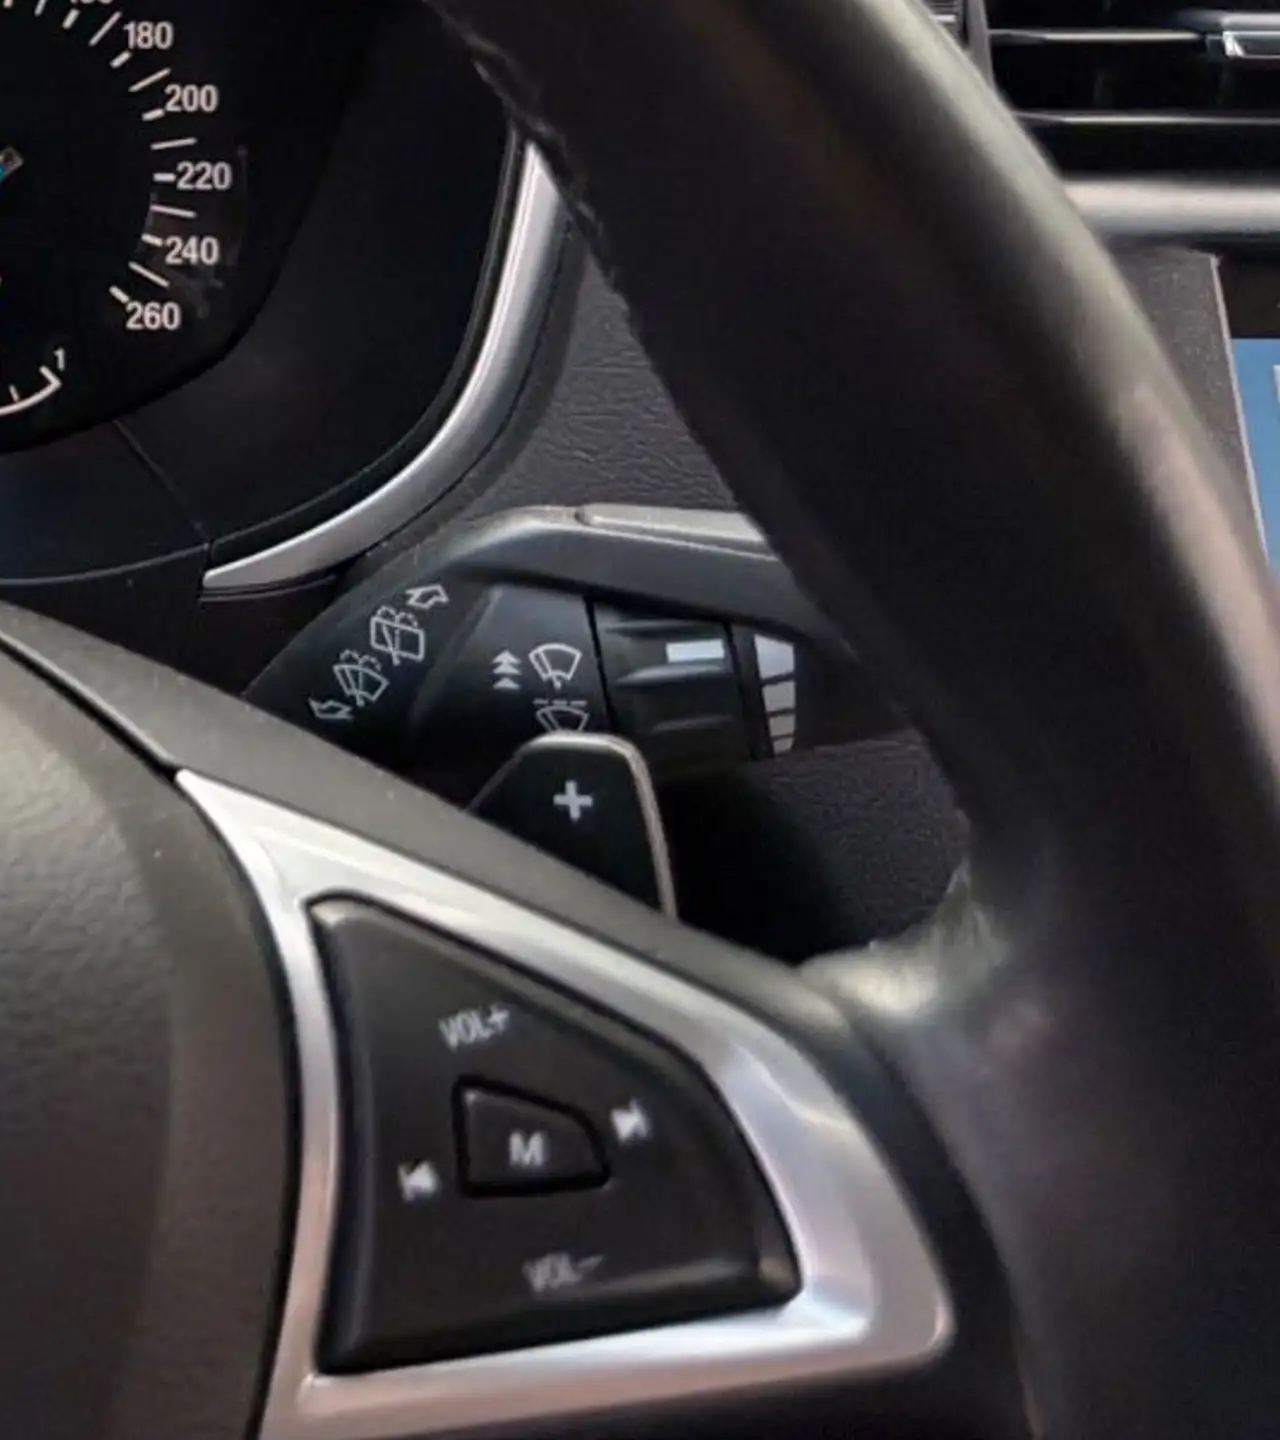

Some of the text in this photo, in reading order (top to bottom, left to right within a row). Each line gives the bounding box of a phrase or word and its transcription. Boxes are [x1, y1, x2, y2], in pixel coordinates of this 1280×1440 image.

[123, 21, 174, 50] 180
[164, 84, 219, 112] 200
[177, 162, 233, 190] 220
[164, 236, 219, 264] 240
[126, 301, 181, 330] 260
[54, 347, 66, 369] 1
[438, 1004, 510, 1050] VOL+
[508, 1128, 546, 1166] M
